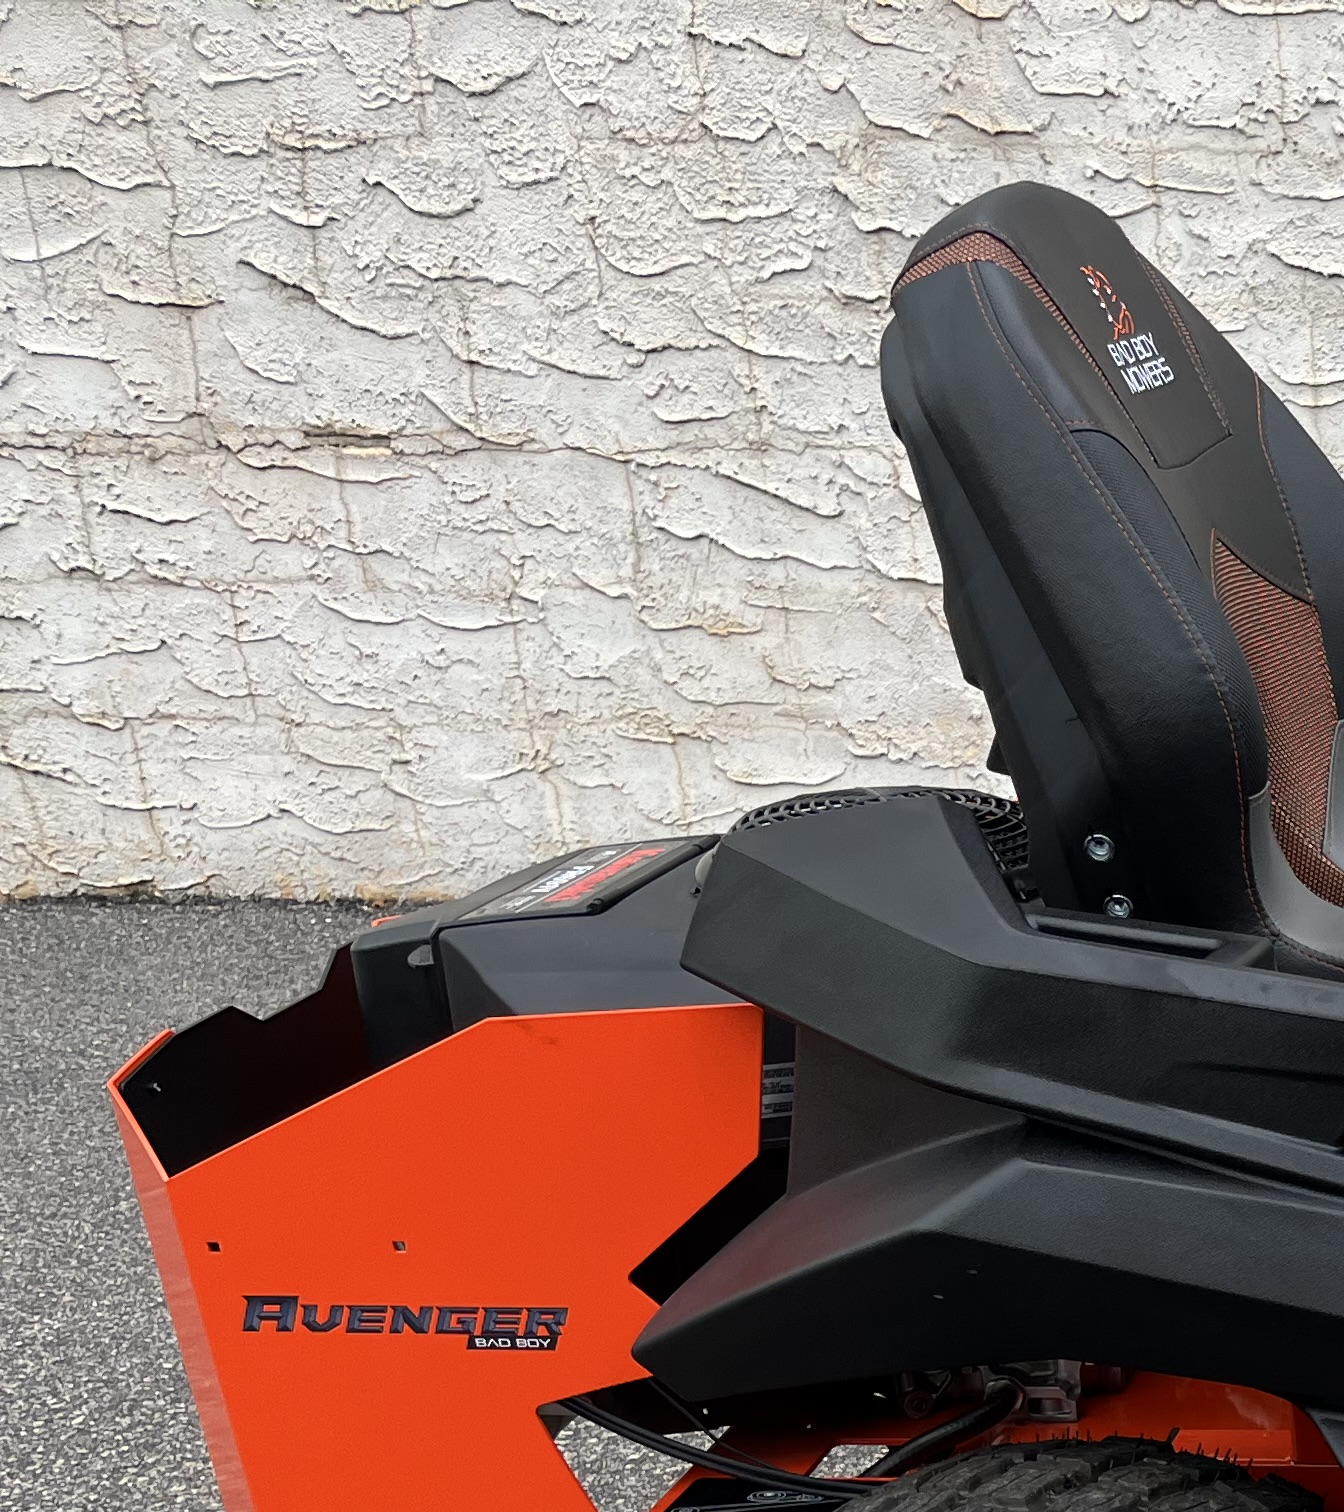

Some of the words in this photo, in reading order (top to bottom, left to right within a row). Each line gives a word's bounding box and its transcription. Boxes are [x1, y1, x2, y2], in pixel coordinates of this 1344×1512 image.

[1107, 340, 1136, 367] BAD
[1130, 332, 1160, 361] BOY
[1120, 357, 1175, 394] MOWERS
[475, 1338, 510, 1348] BAD
[516, 1338, 551, 1348] BOY
